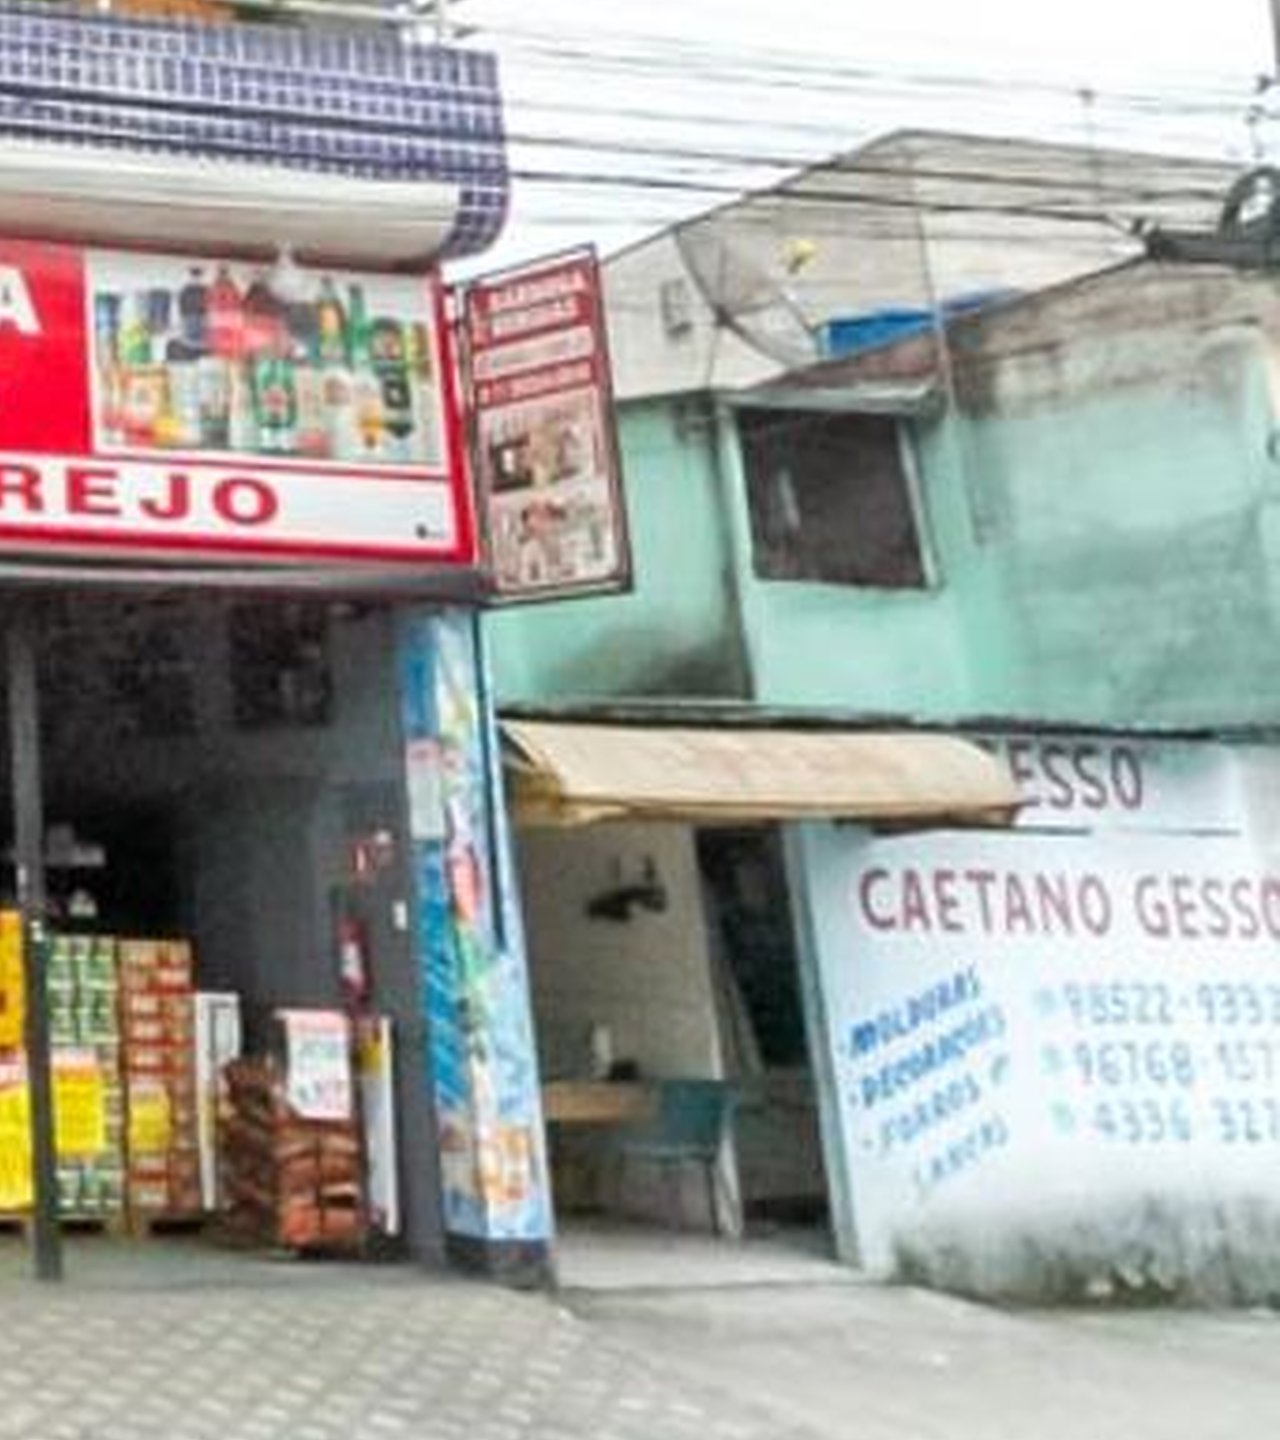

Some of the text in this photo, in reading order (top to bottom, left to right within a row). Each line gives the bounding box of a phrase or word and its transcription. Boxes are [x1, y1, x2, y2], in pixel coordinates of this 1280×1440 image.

[982, 738, 1142, 810] ESSO
[859, 868, 1280, 941] CAETANO GESSO
